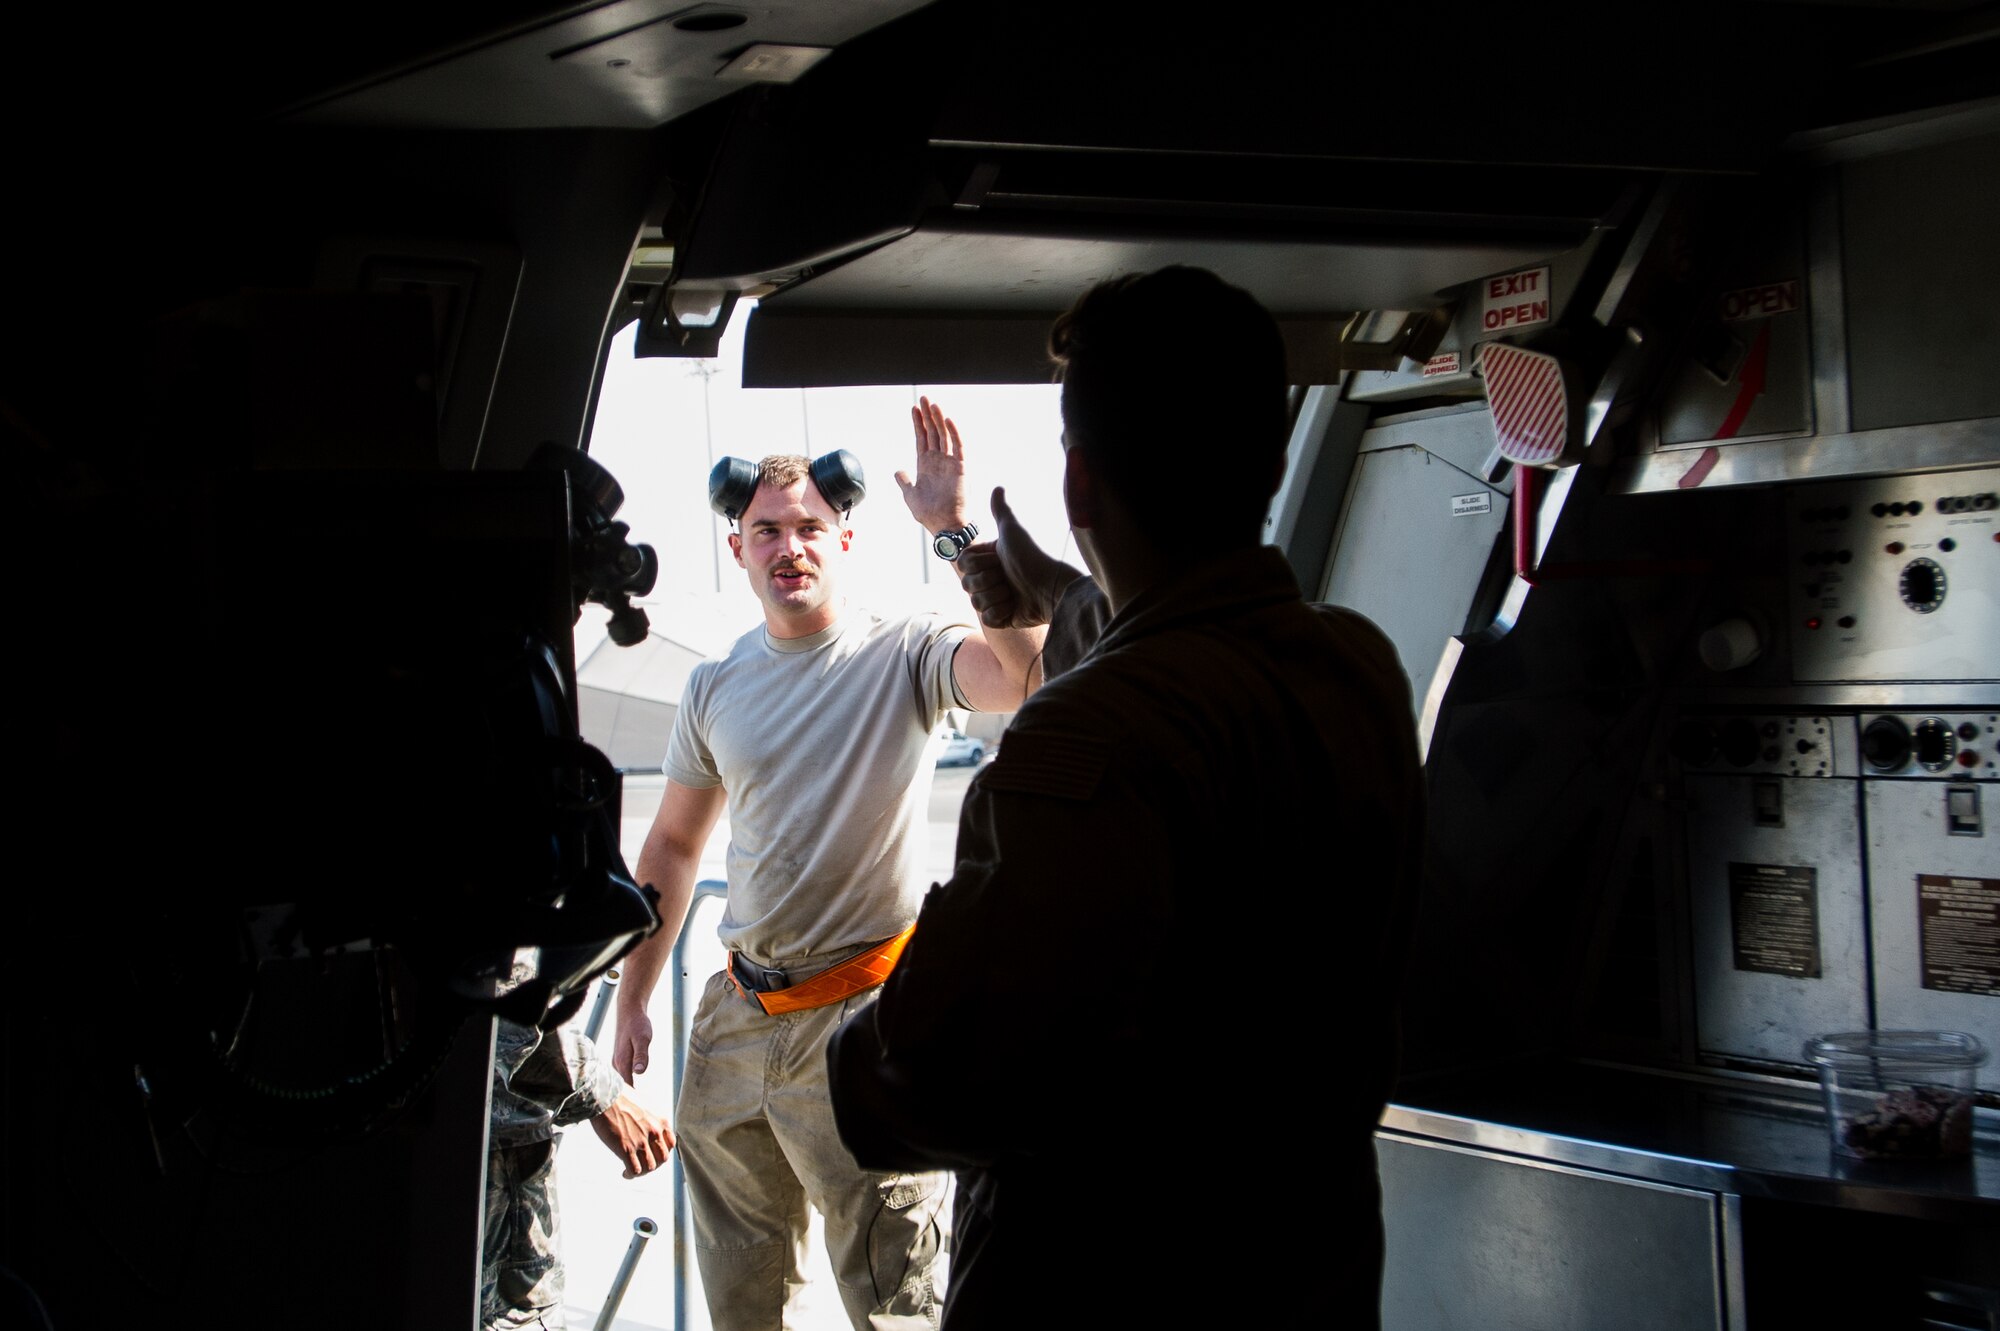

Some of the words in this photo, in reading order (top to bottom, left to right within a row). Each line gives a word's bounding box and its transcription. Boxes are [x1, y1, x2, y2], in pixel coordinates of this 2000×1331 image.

[1489, 271, 1541, 299] EXIT
[1725, 282, 1796, 317] OPEN
[1484, 301, 1547, 329] OPEN
[1424, 364, 1458, 375] ARMED
[1428, 356, 1455, 366] SLIDE
